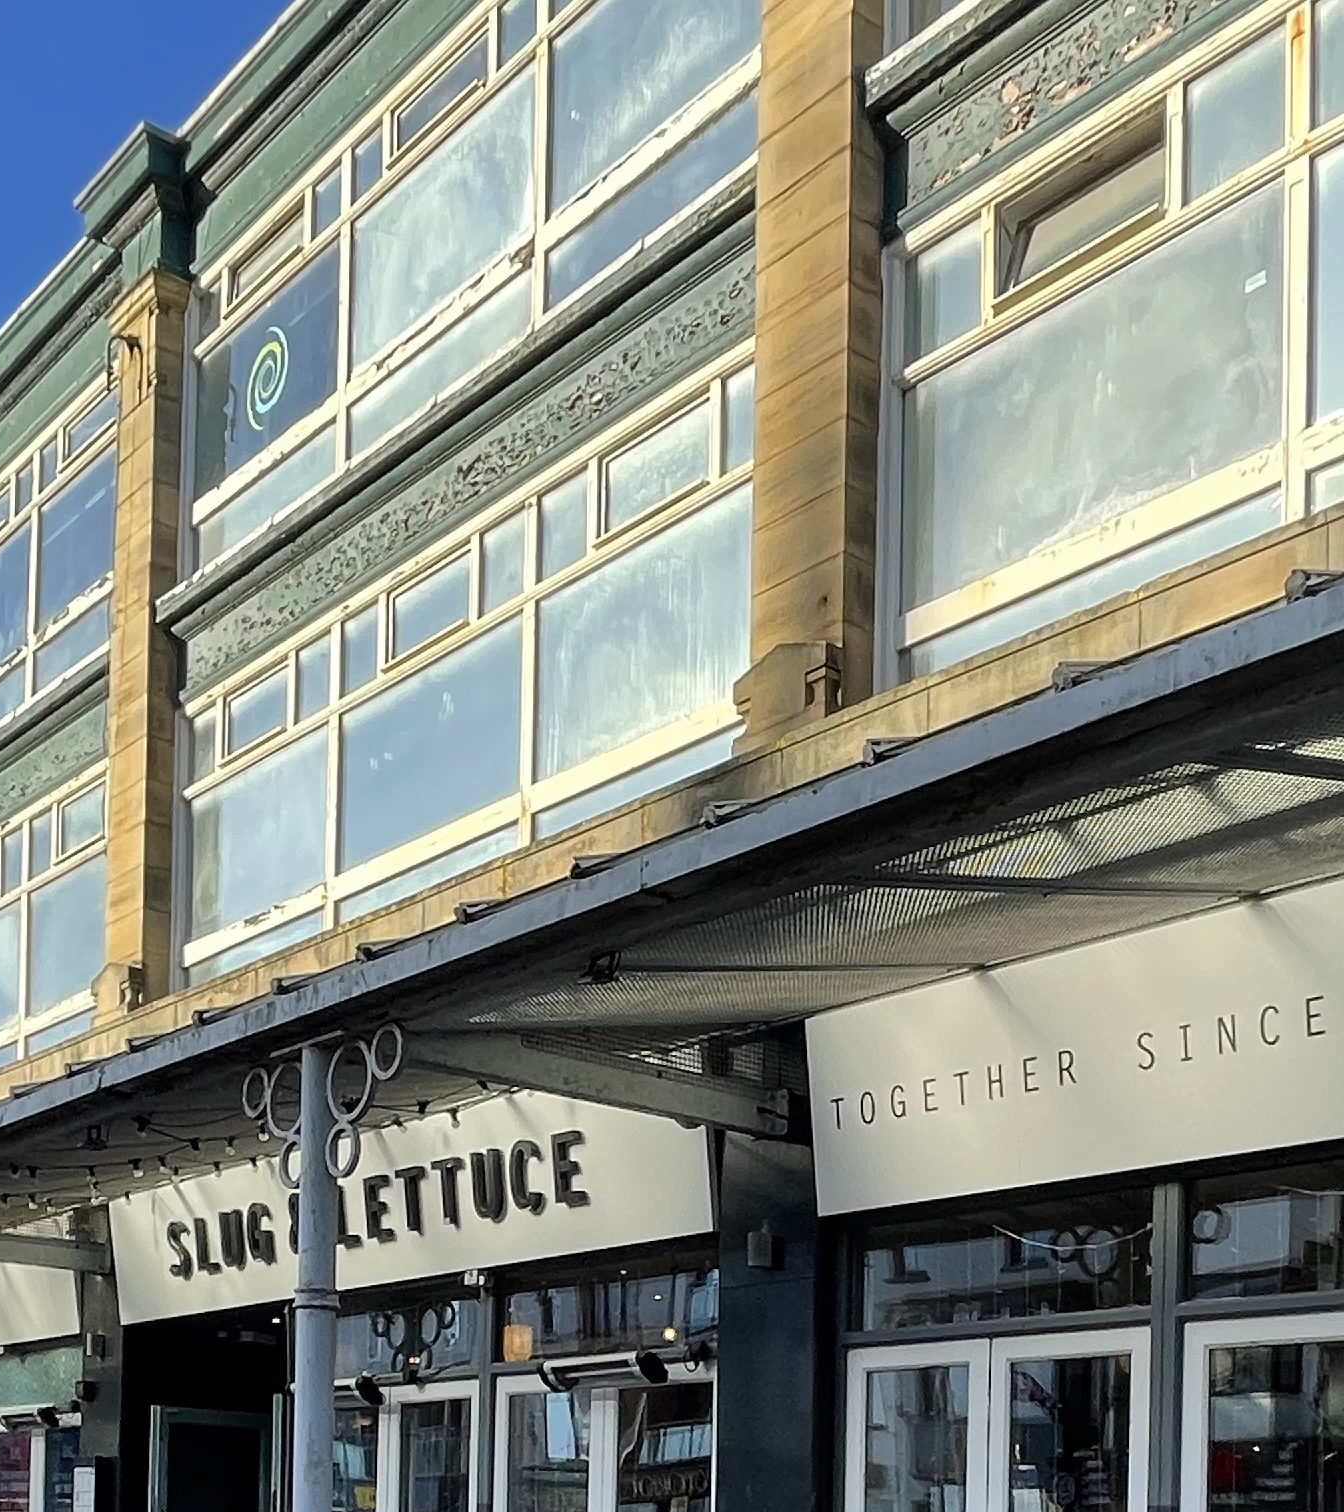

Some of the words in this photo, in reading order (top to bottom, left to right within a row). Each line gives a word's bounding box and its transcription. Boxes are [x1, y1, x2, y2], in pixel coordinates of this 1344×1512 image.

[830, 1049, 1078, 1131] TOGETHER
[1137, 995, 1327, 1071] SINCE
[167, 1202, 277, 1281] SLUG
[335, 1130, 591, 1250] LETTUCE
